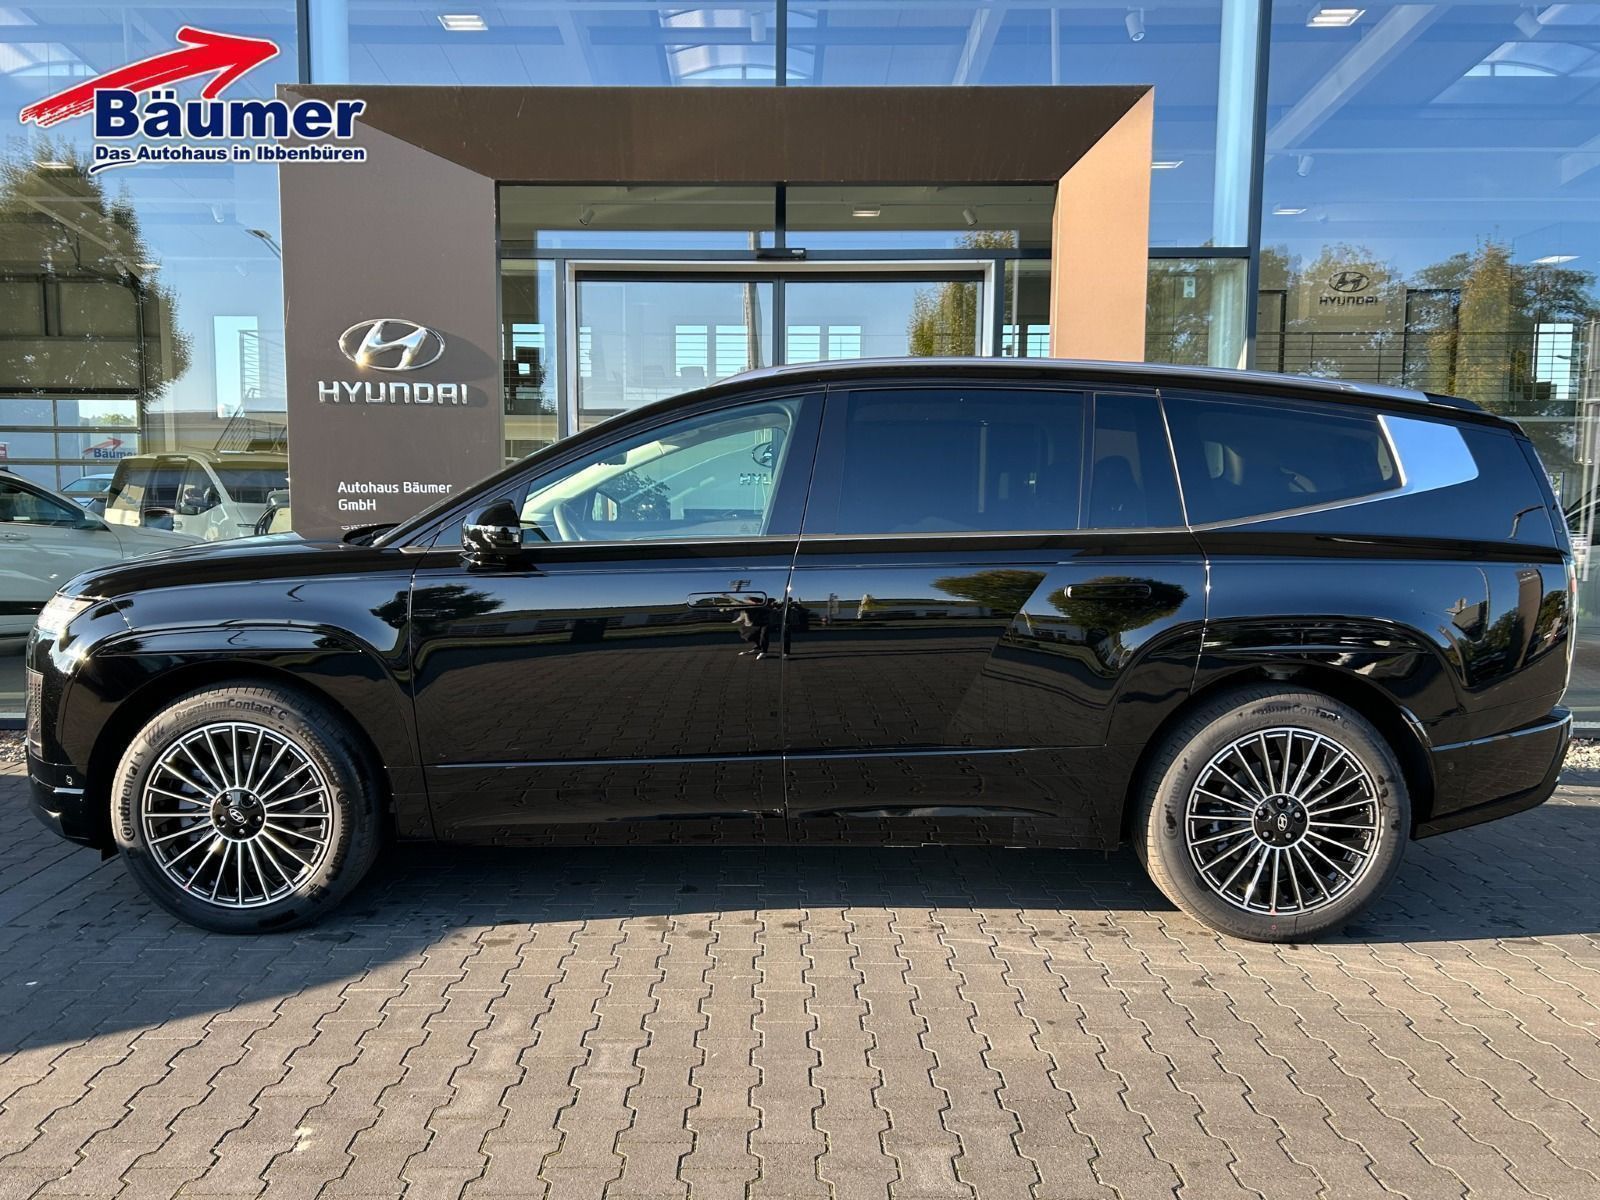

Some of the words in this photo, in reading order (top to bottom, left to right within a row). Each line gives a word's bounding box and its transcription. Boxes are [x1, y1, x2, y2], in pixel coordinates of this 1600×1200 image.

[1319, 296, 1378, 306] HYUNDAI
[318, 381, 468, 404] HYUNDAI
[337, 482, 399, 494] Autohaus
[404, 482, 452, 494] Bäumer
[338, 499, 377, 511] GmbH
